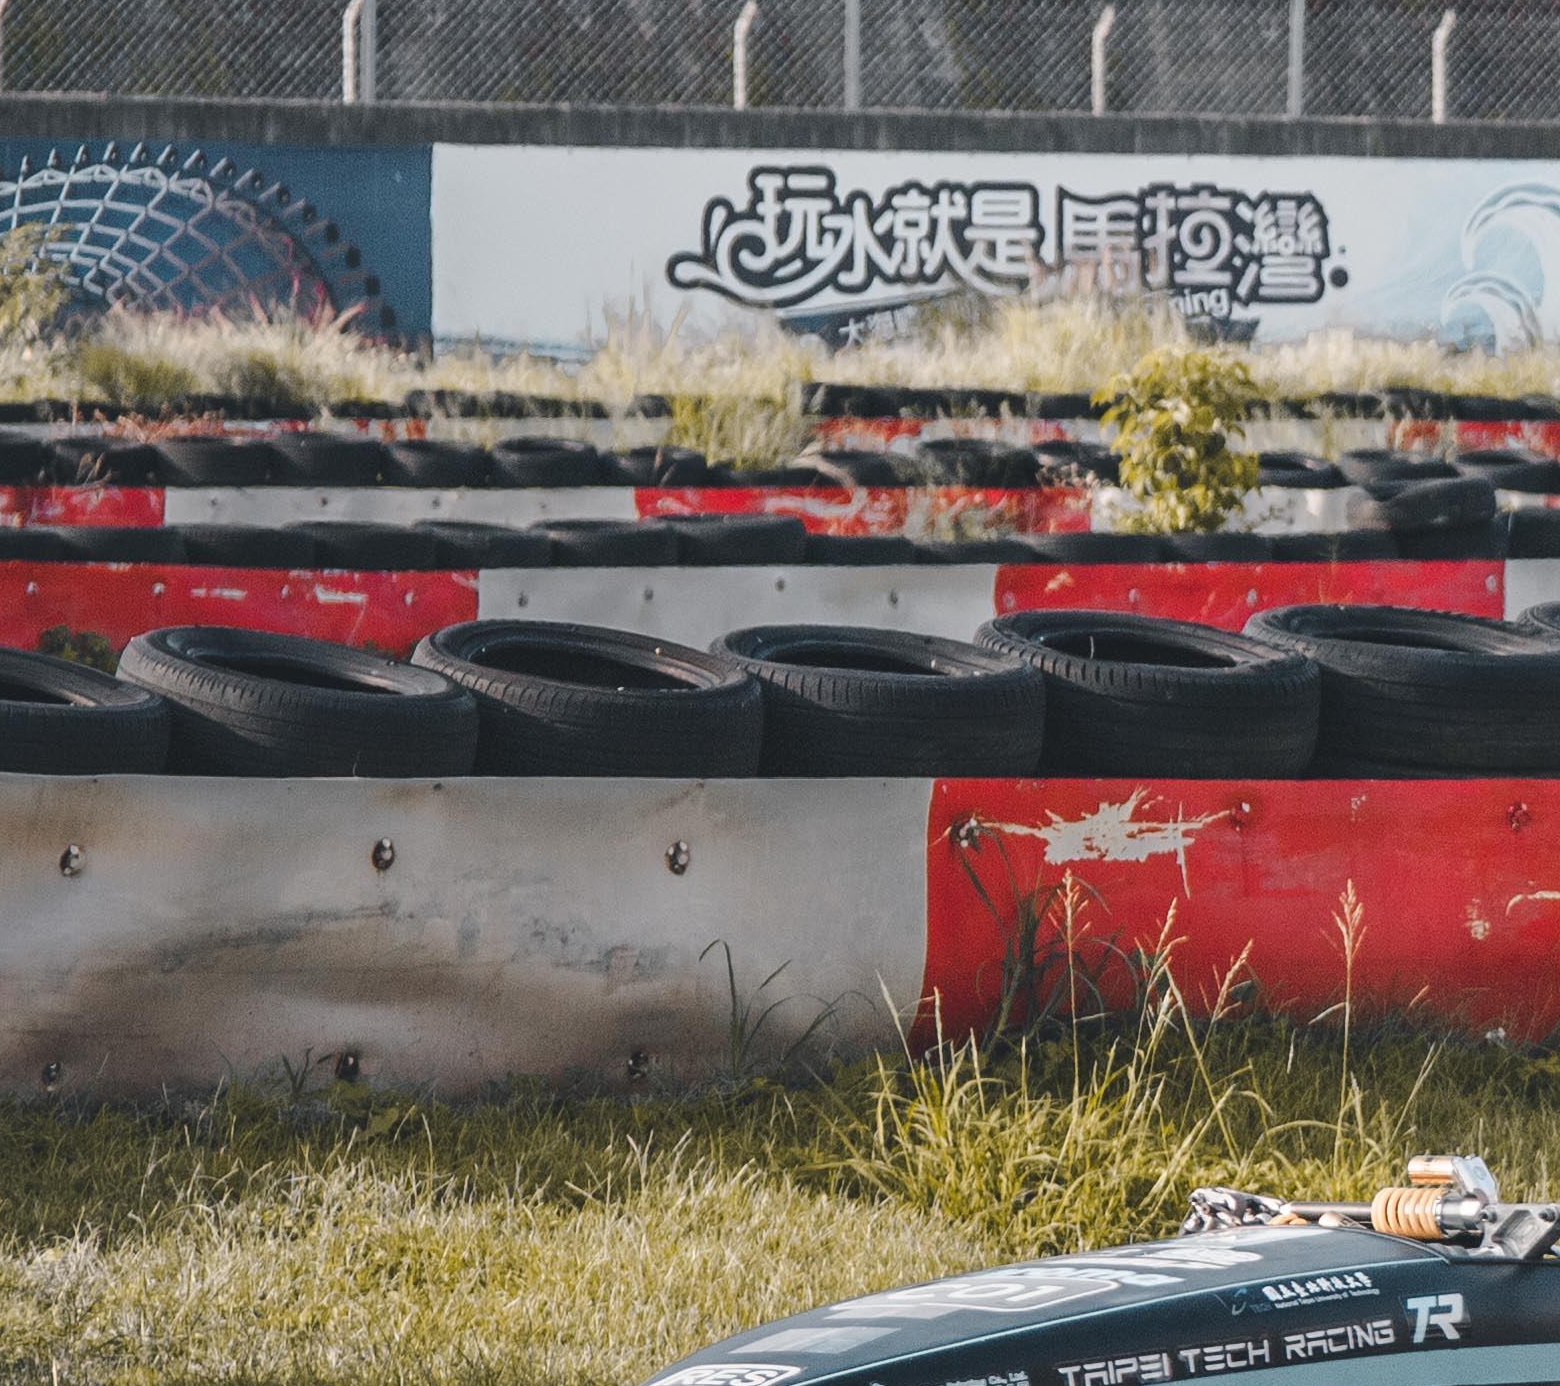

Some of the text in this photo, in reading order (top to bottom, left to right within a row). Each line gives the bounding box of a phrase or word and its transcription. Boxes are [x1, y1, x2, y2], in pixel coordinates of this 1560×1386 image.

[1407, 1292, 1464, 1343] TR
[1178, 1339, 1271, 1373] TECH
[1284, 1319, 1395, 1360] RACING
